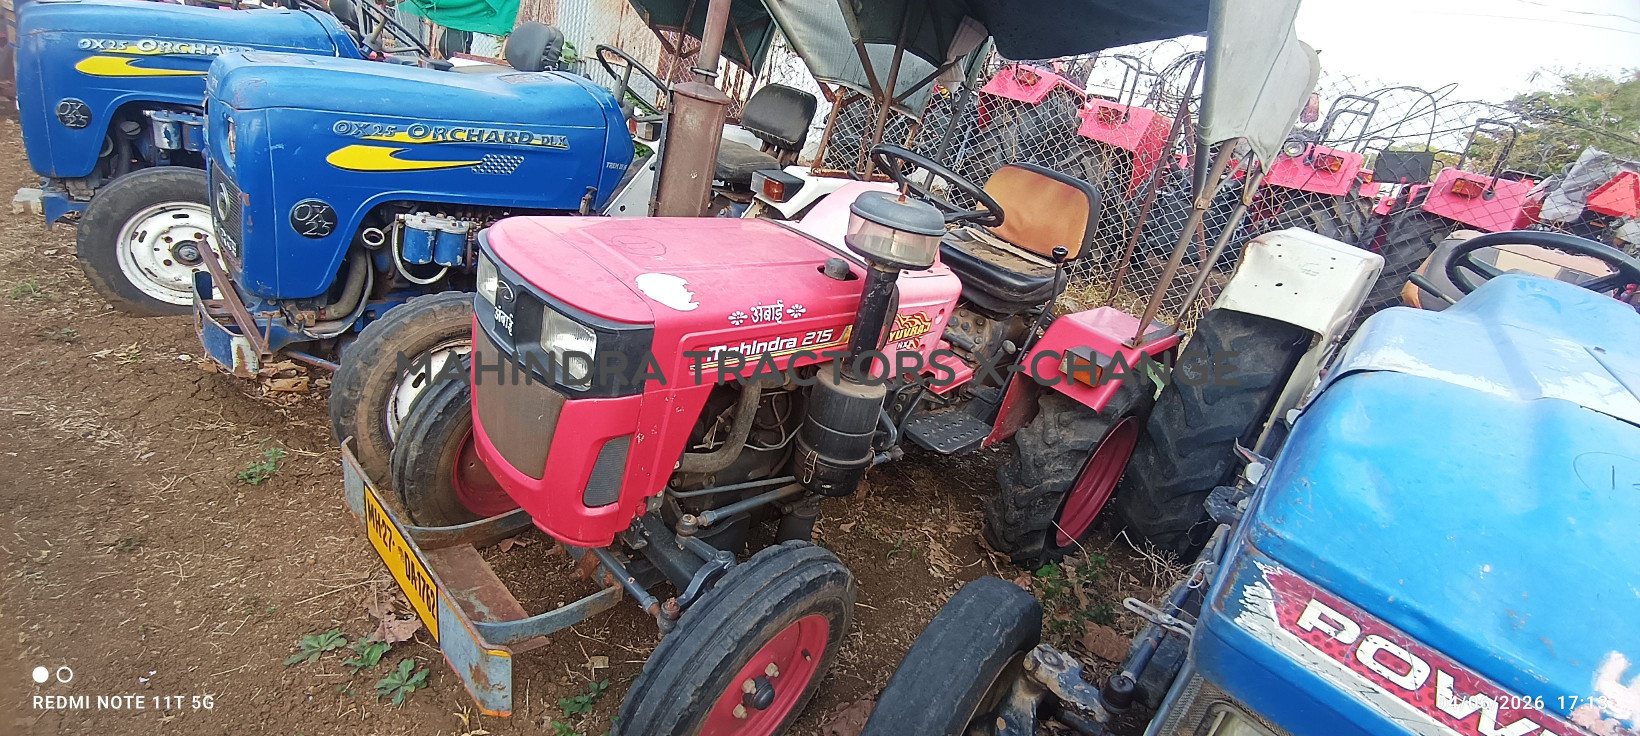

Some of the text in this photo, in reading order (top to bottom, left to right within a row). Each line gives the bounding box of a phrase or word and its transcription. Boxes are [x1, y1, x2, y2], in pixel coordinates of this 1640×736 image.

[58, 101, 84, 116] OX
[65, 114, 89, 128] 25
[406, 123, 535, 145] ORCHARD
[541, 135, 567, 147] DLX
[293, 203, 330, 222] OX
[302, 220, 334, 237] 25
[801, 328, 834, 346] 215
[889, 322, 931, 342] YUVRAJ
[1296, 598, 1560, 736] POW
